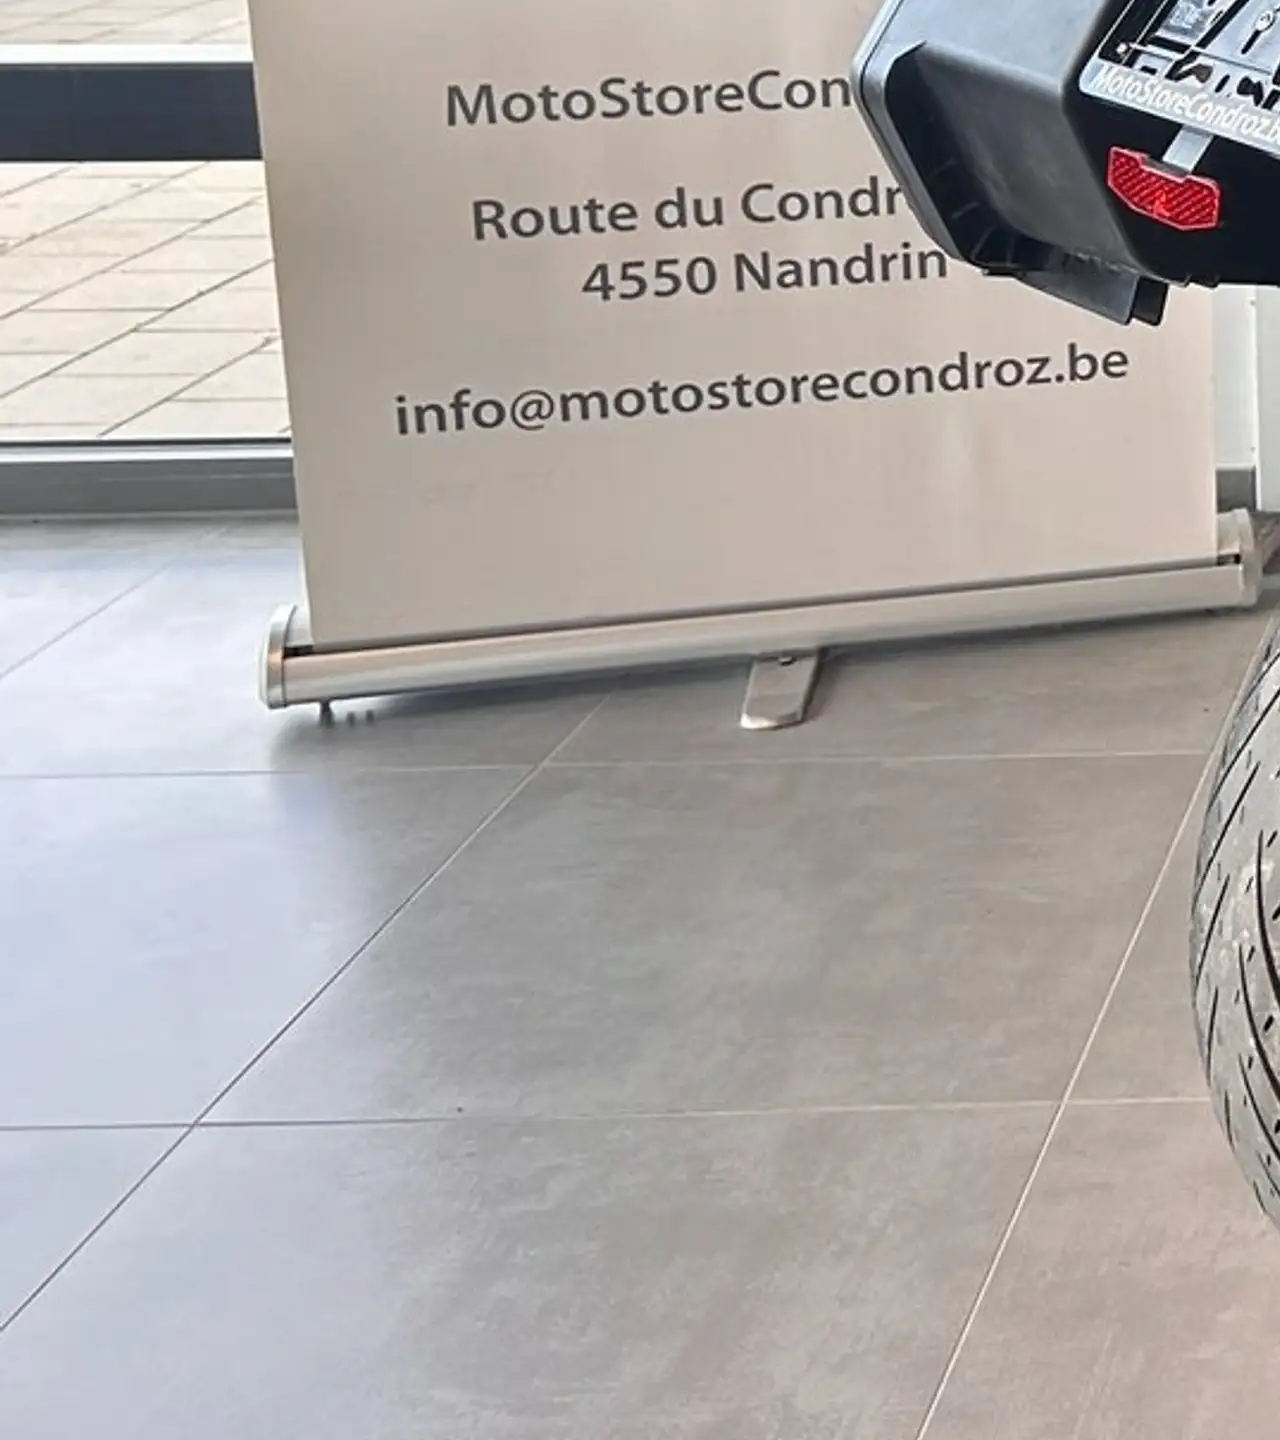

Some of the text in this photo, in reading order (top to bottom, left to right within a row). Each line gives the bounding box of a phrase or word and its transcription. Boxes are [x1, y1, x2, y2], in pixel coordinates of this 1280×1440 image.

[446, 69, 852, 126] MotoStoreCon
[472, 175, 903, 241] Route du Condr
[582, 243, 949, 302] 4550 Nandrin
[395, 343, 1130, 436] info@motostorecondroz.be
